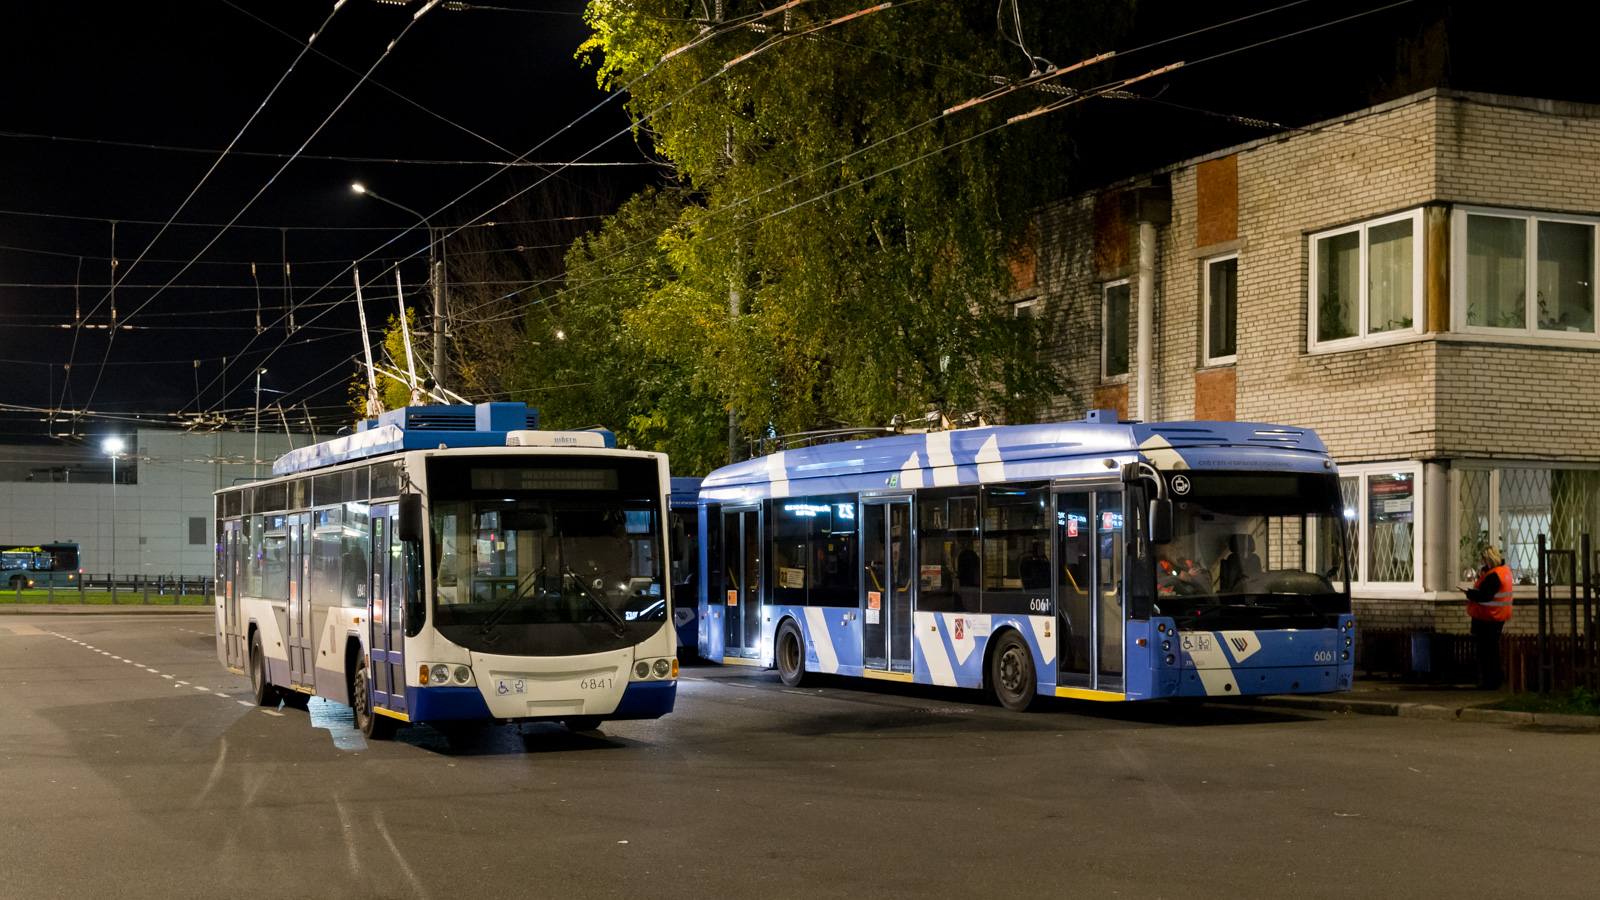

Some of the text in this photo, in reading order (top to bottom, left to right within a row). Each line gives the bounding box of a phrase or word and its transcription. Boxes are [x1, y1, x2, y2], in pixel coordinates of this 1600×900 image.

[1030, 598, 1049, 611] 6061
[1314, 651, 1336, 661] 6061
[580, 678, 613, 690] 6841
